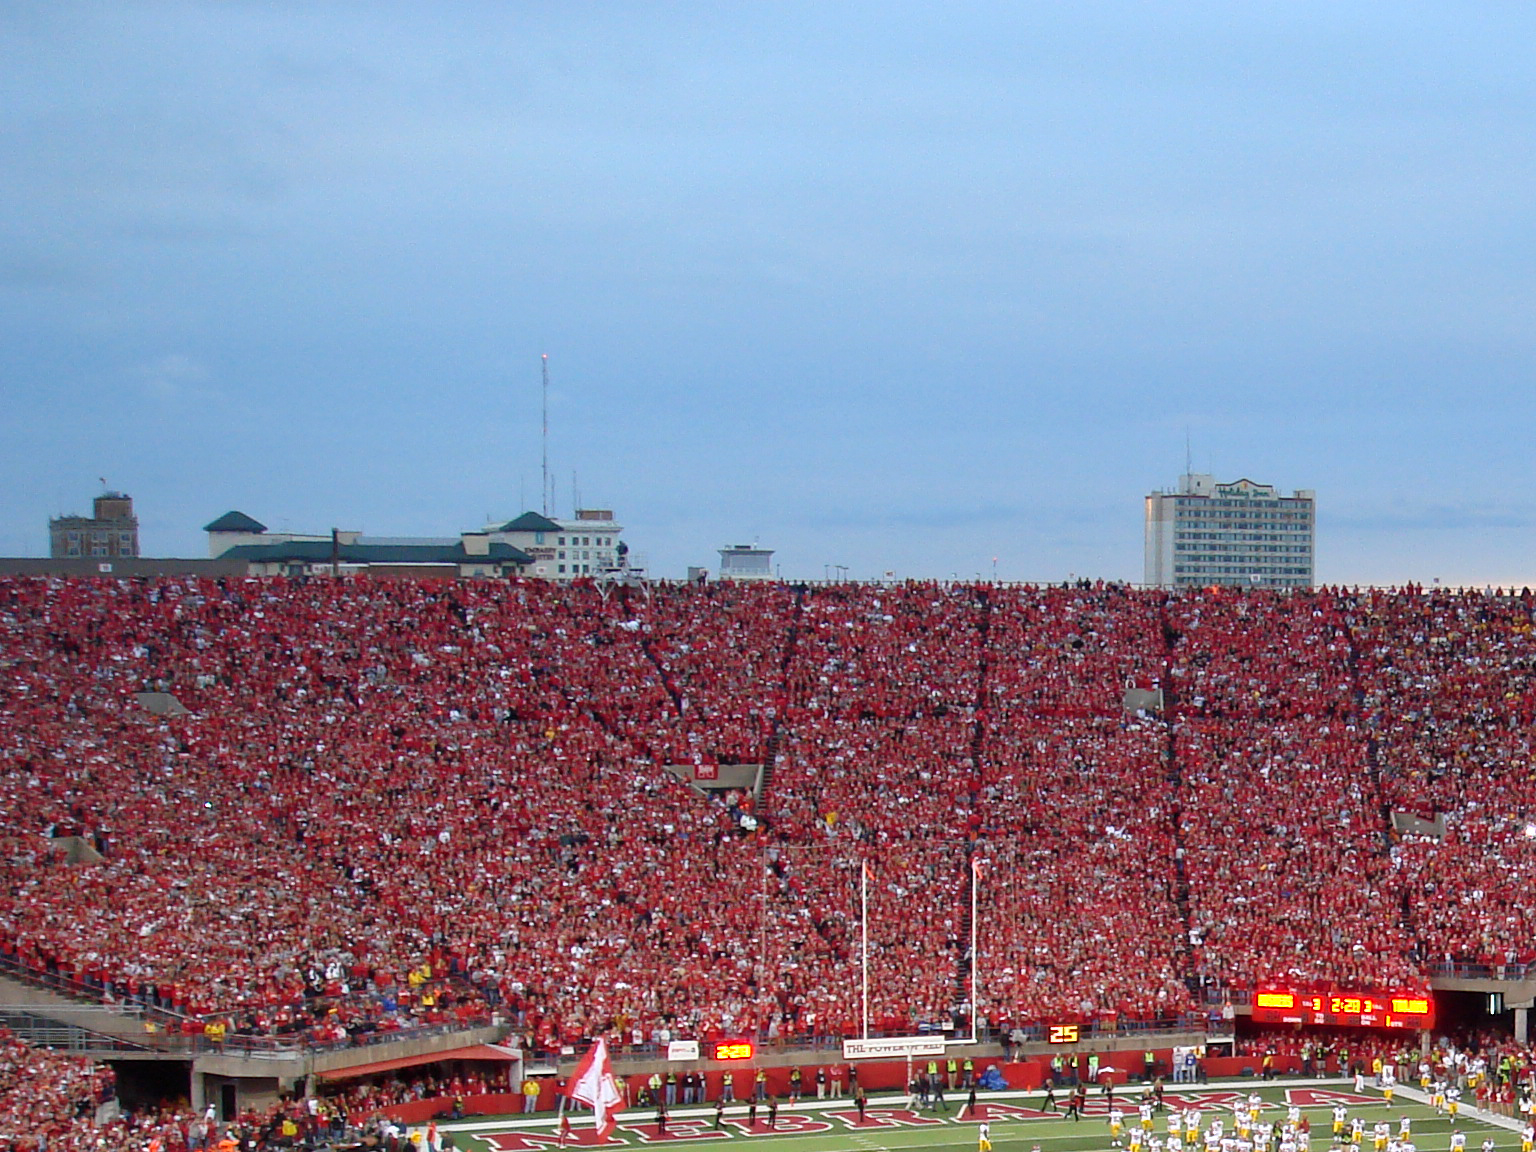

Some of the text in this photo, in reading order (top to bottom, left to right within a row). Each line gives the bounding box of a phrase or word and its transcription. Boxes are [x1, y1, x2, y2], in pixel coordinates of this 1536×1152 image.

[1313, 998, 1320, 1010] 3
[1332, 998, 1360, 1013] 2:28
[1364, 1000, 1372, 1012] 3
[1050, 1026, 1078, 1042] 25
[717, 1044, 750, 1059] 2:28
[847, 1045, 866, 1053] THE
[471, 1086, 1389, 1152] NEBRASKA
